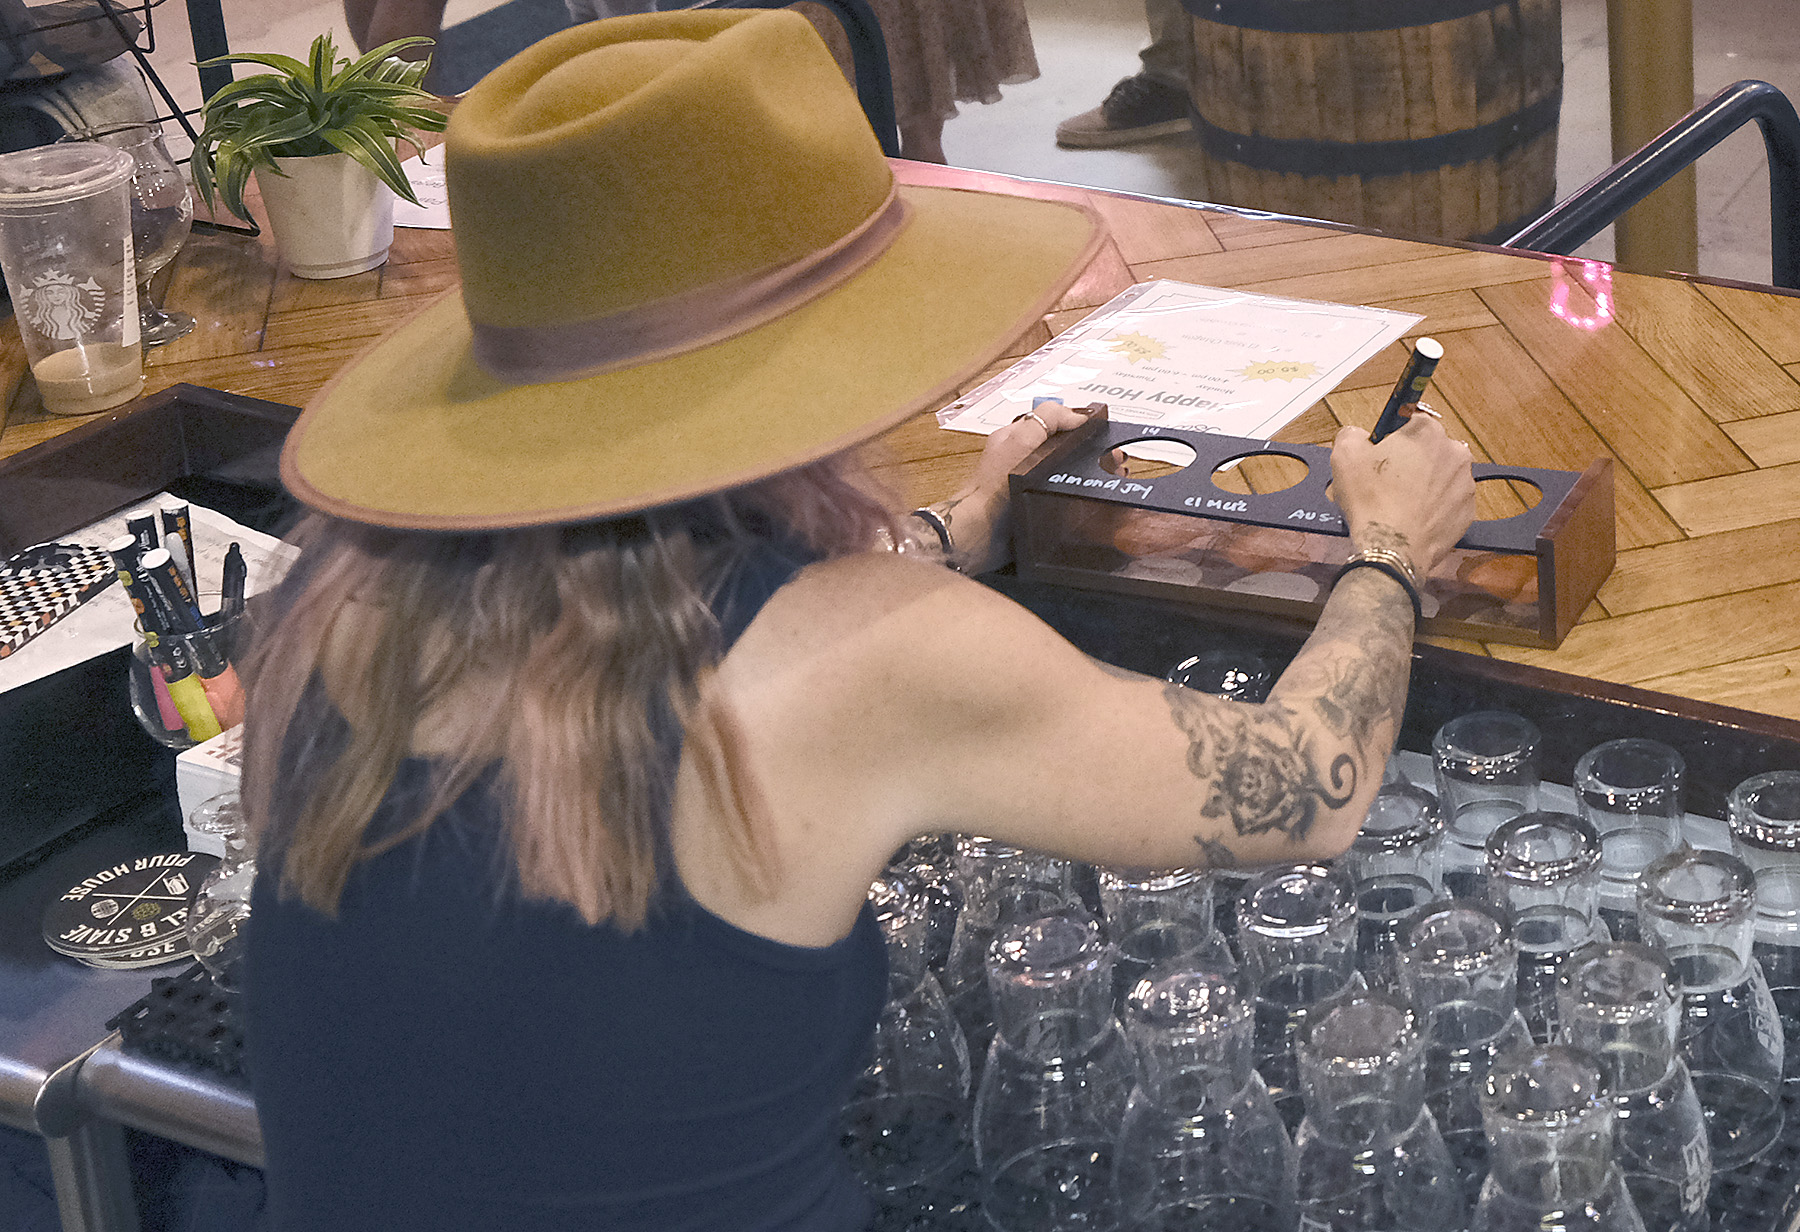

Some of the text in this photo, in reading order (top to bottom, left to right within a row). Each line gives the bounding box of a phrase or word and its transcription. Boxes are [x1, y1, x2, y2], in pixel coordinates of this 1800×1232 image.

[1077, 383, 1145, 402] Hour
[59, 854, 195, 903] POUR HOUSE
[59, 923, 133, 945] STAVE
